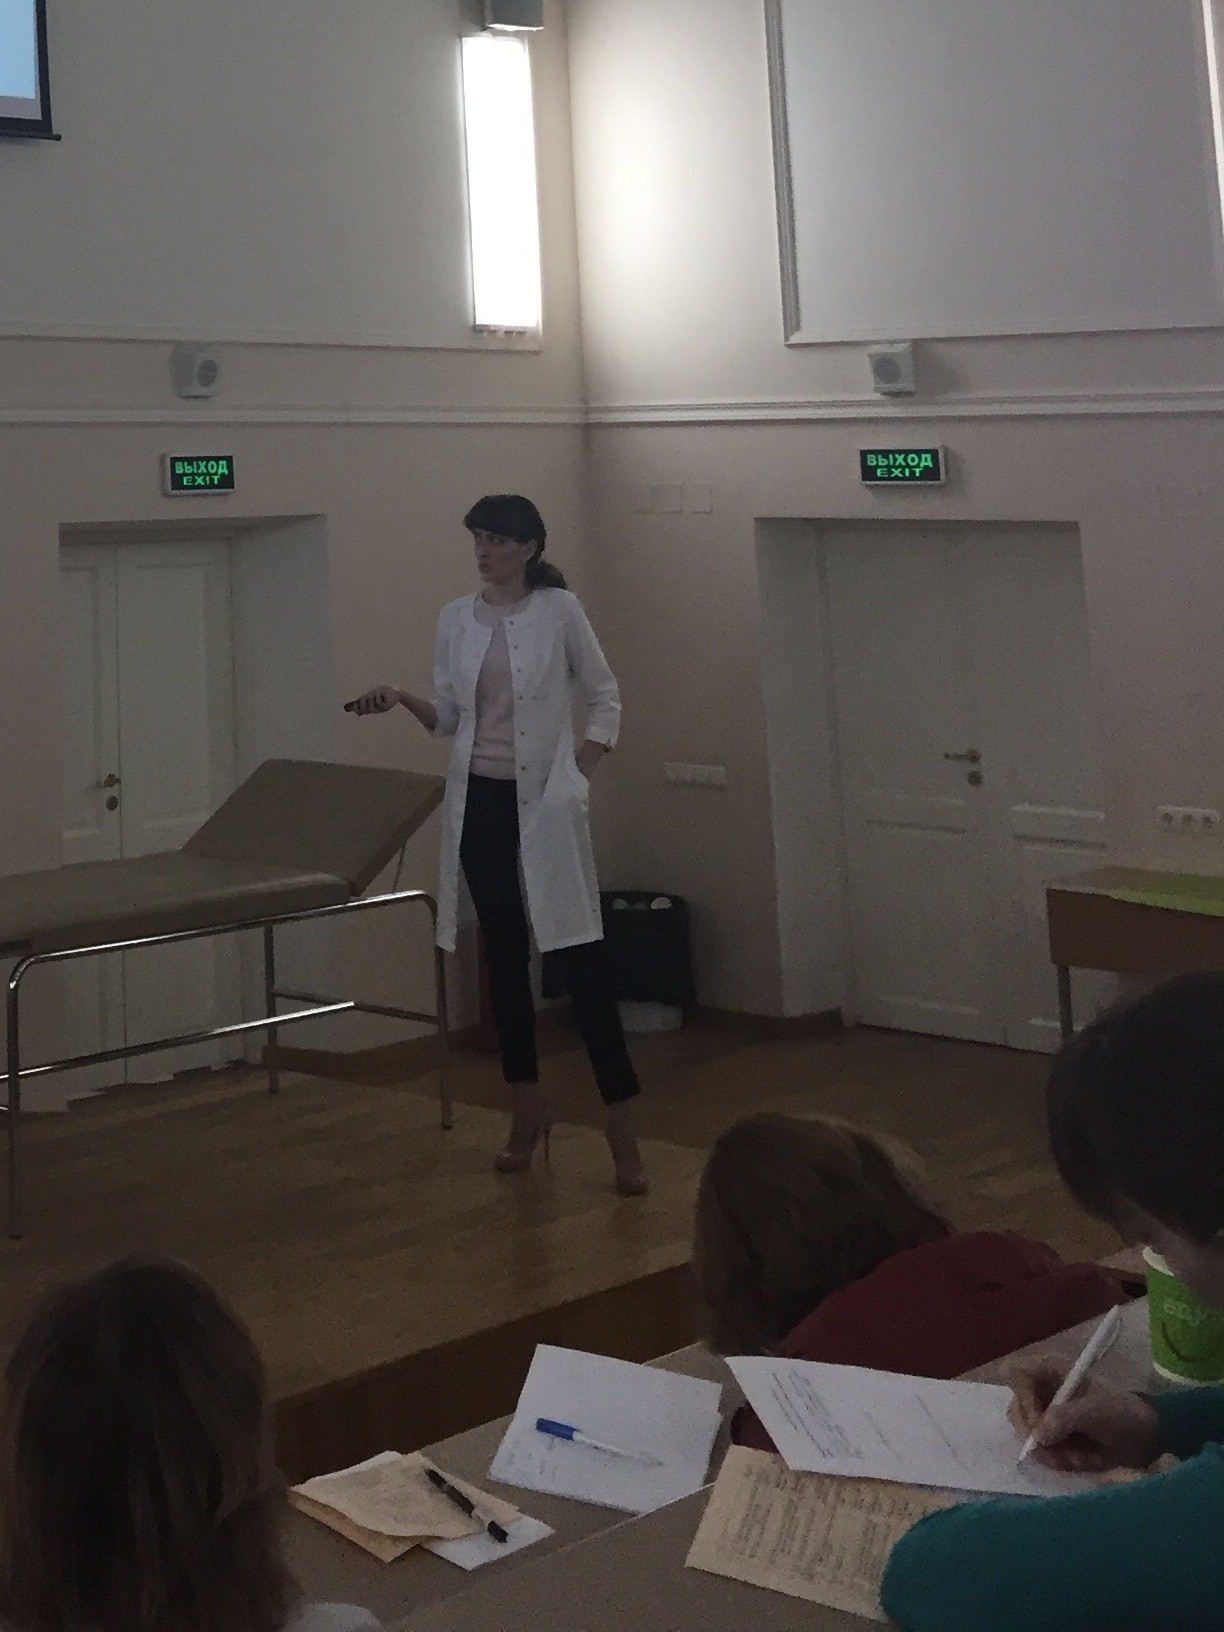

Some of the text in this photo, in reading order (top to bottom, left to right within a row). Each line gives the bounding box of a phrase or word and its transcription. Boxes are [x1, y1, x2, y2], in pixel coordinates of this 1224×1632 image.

[867, 454, 933, 467] ВЫХОД
[175, 460, 228, 475] ВЫХОД
[877, 468, 923, 477] EXIT
[183, 476, 220, 485] EXIT
